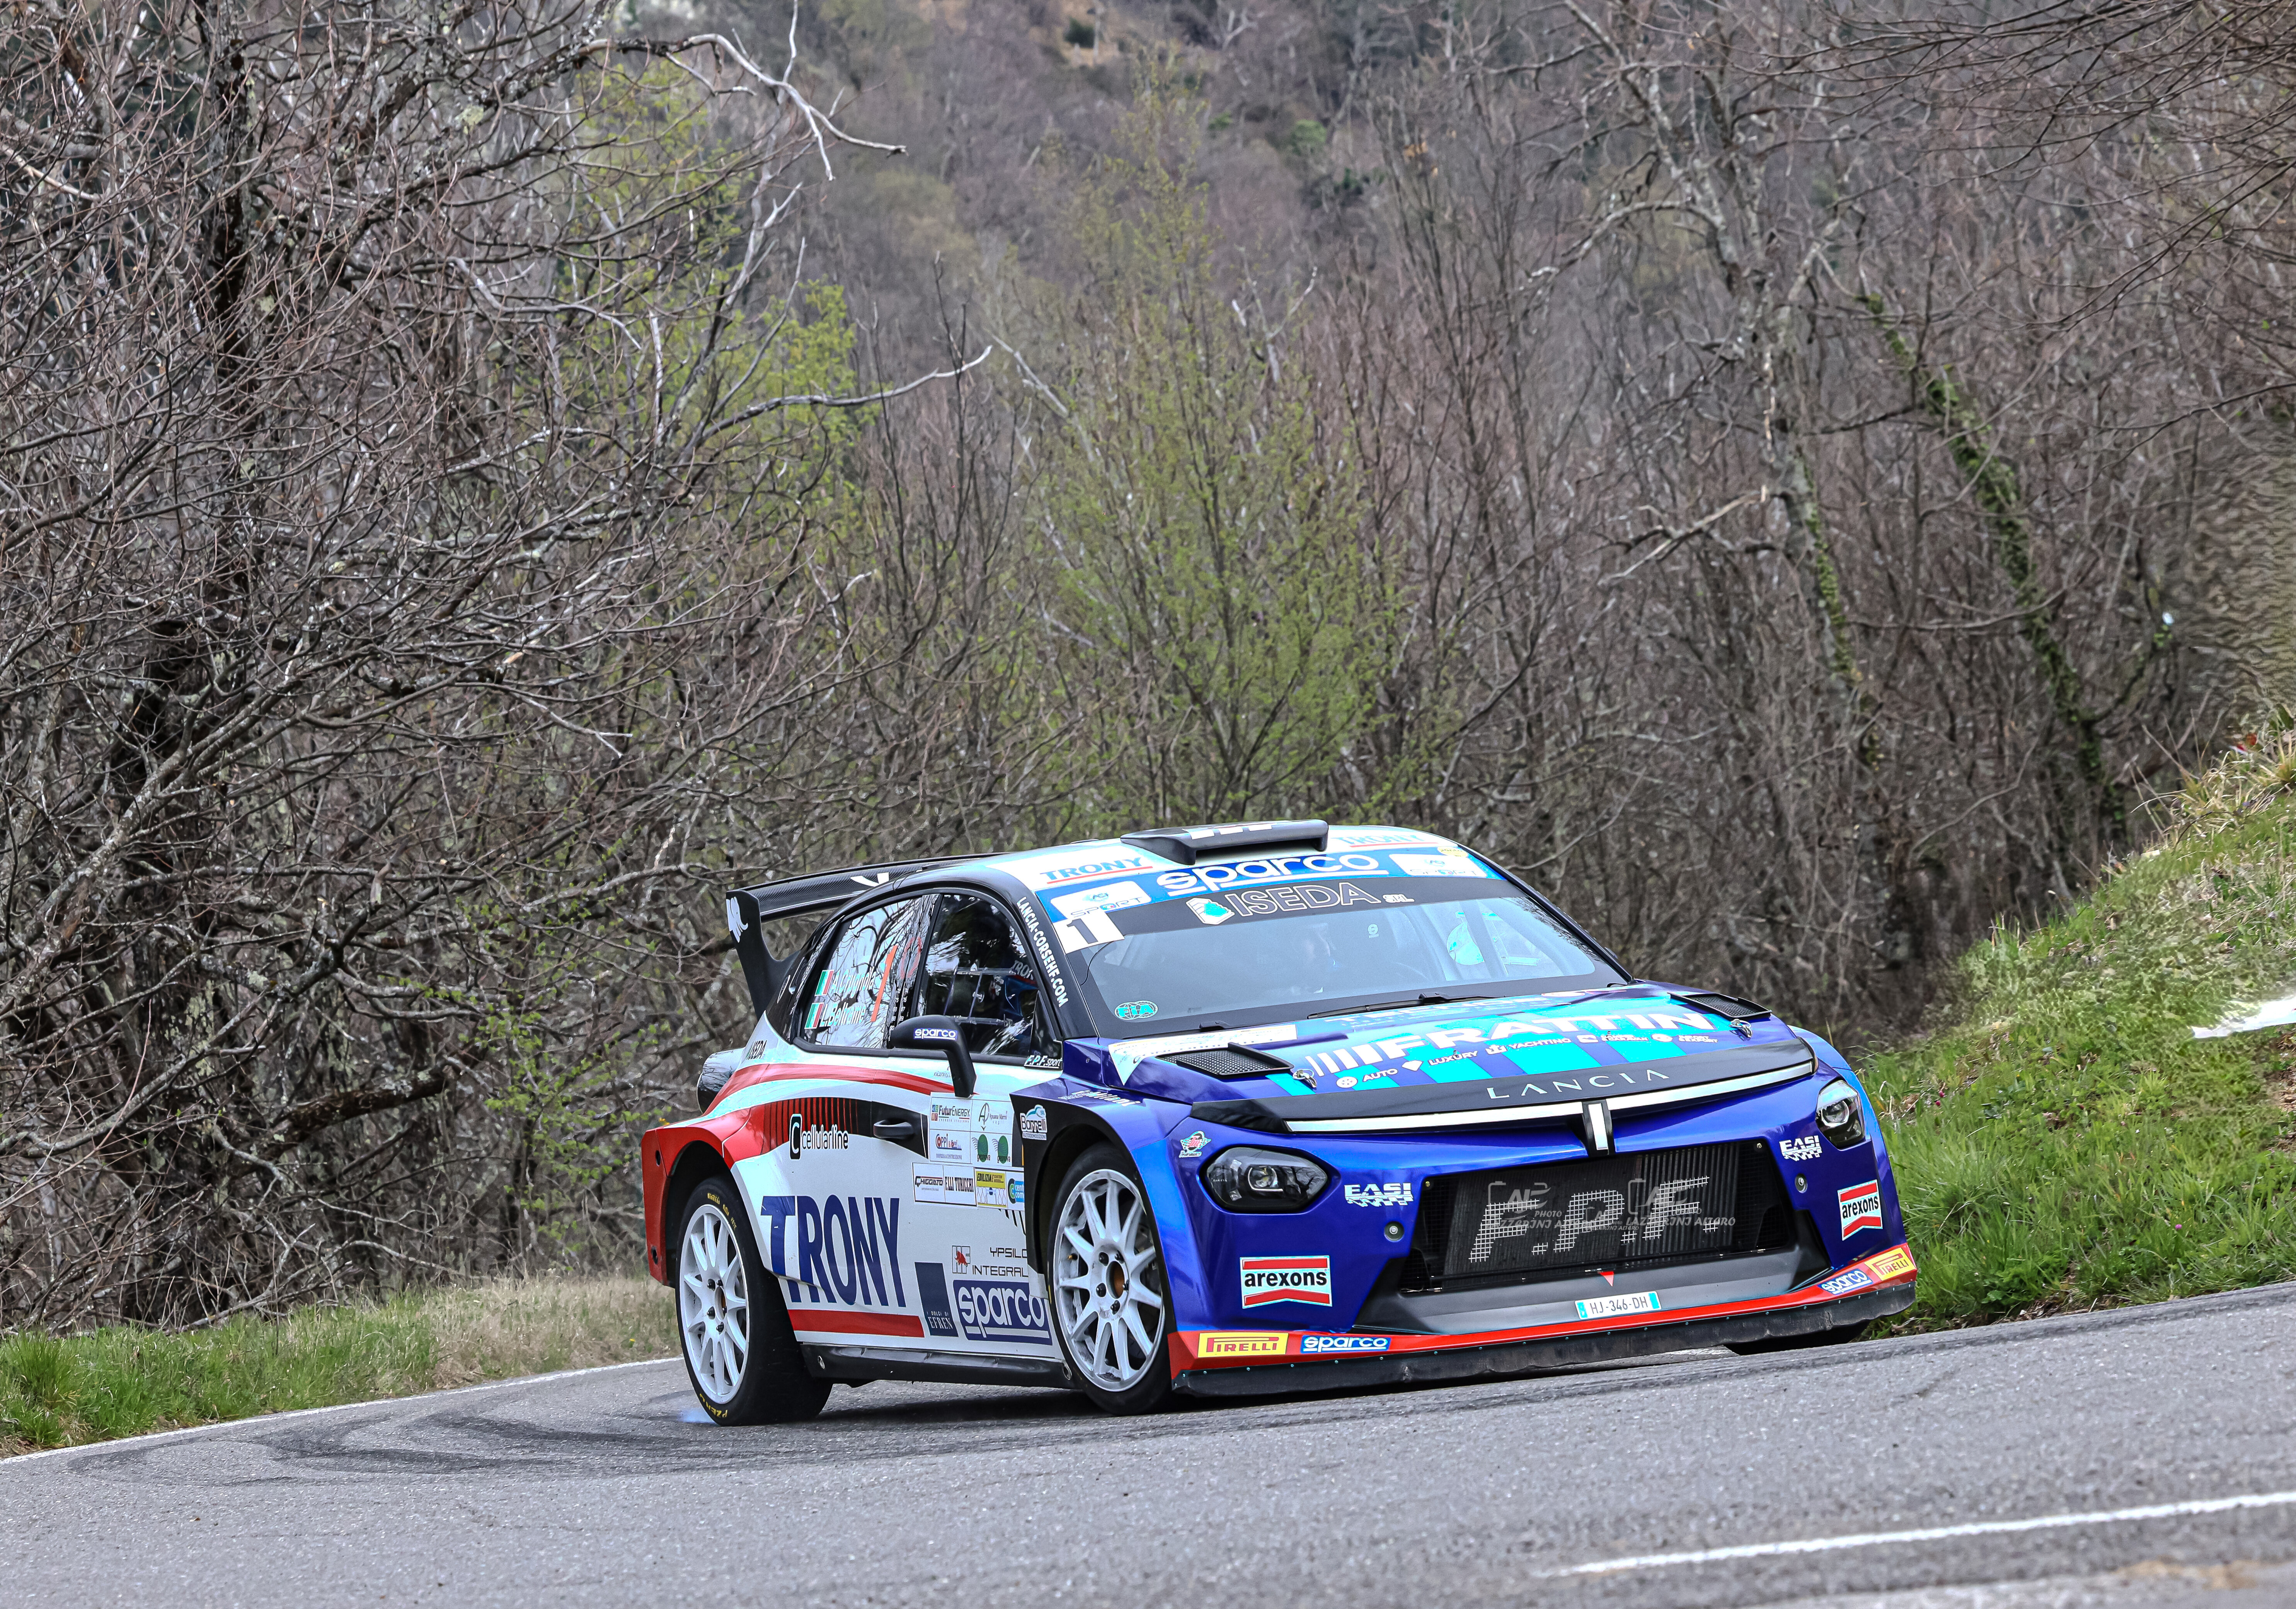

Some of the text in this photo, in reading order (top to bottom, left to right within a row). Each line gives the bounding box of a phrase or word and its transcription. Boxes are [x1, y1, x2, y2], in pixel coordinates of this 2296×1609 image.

[1040, 857, 1142, 880] TRONY
[1157, 854, 1379, 891] sparco
[1070, 897, 1143, 917] SPORT
[1225, 882, 1415, 917] ISEDA SRL
[1066, 918, 1099, 944] 1
[1017, 897, 1068, 1007] LANCIA-CORSEHF.COM
[830, 967, 877, 997] A.Crugnola
[819, 1003, 867, 1027] L.Beltrame
[915, 1029, 956, 1039] sparco
[1377, 1013, 1716, 1059] FRATTIN
[1428, 1050, 1478, 1066] LUXURY
[1363, 1068, 1398, 1082] AUTO
[1487, 1069, 1669, 1099] LANCIA
[802, 1125, 848, 1149] cellularline
[1842, 1196, 1879, 1219] arexons
[761, 1195, 906, 1307] TRONY
[1872, 1253, 1909, 1275] PIRELLI
[1244, 1270, 1327, 1287] arexons
[1821, 1270, 1868, 1293] sparco
[958, 1287, 1044, 1338] sparco
[1590, 1296, 1649, 1314] HJ-346-DH
[928, 1317, 953, 1329] EFREN
[1206, 1336, 1279, 1353] PIRELLI
[1304, 1336, 1388, 1353] sparco
